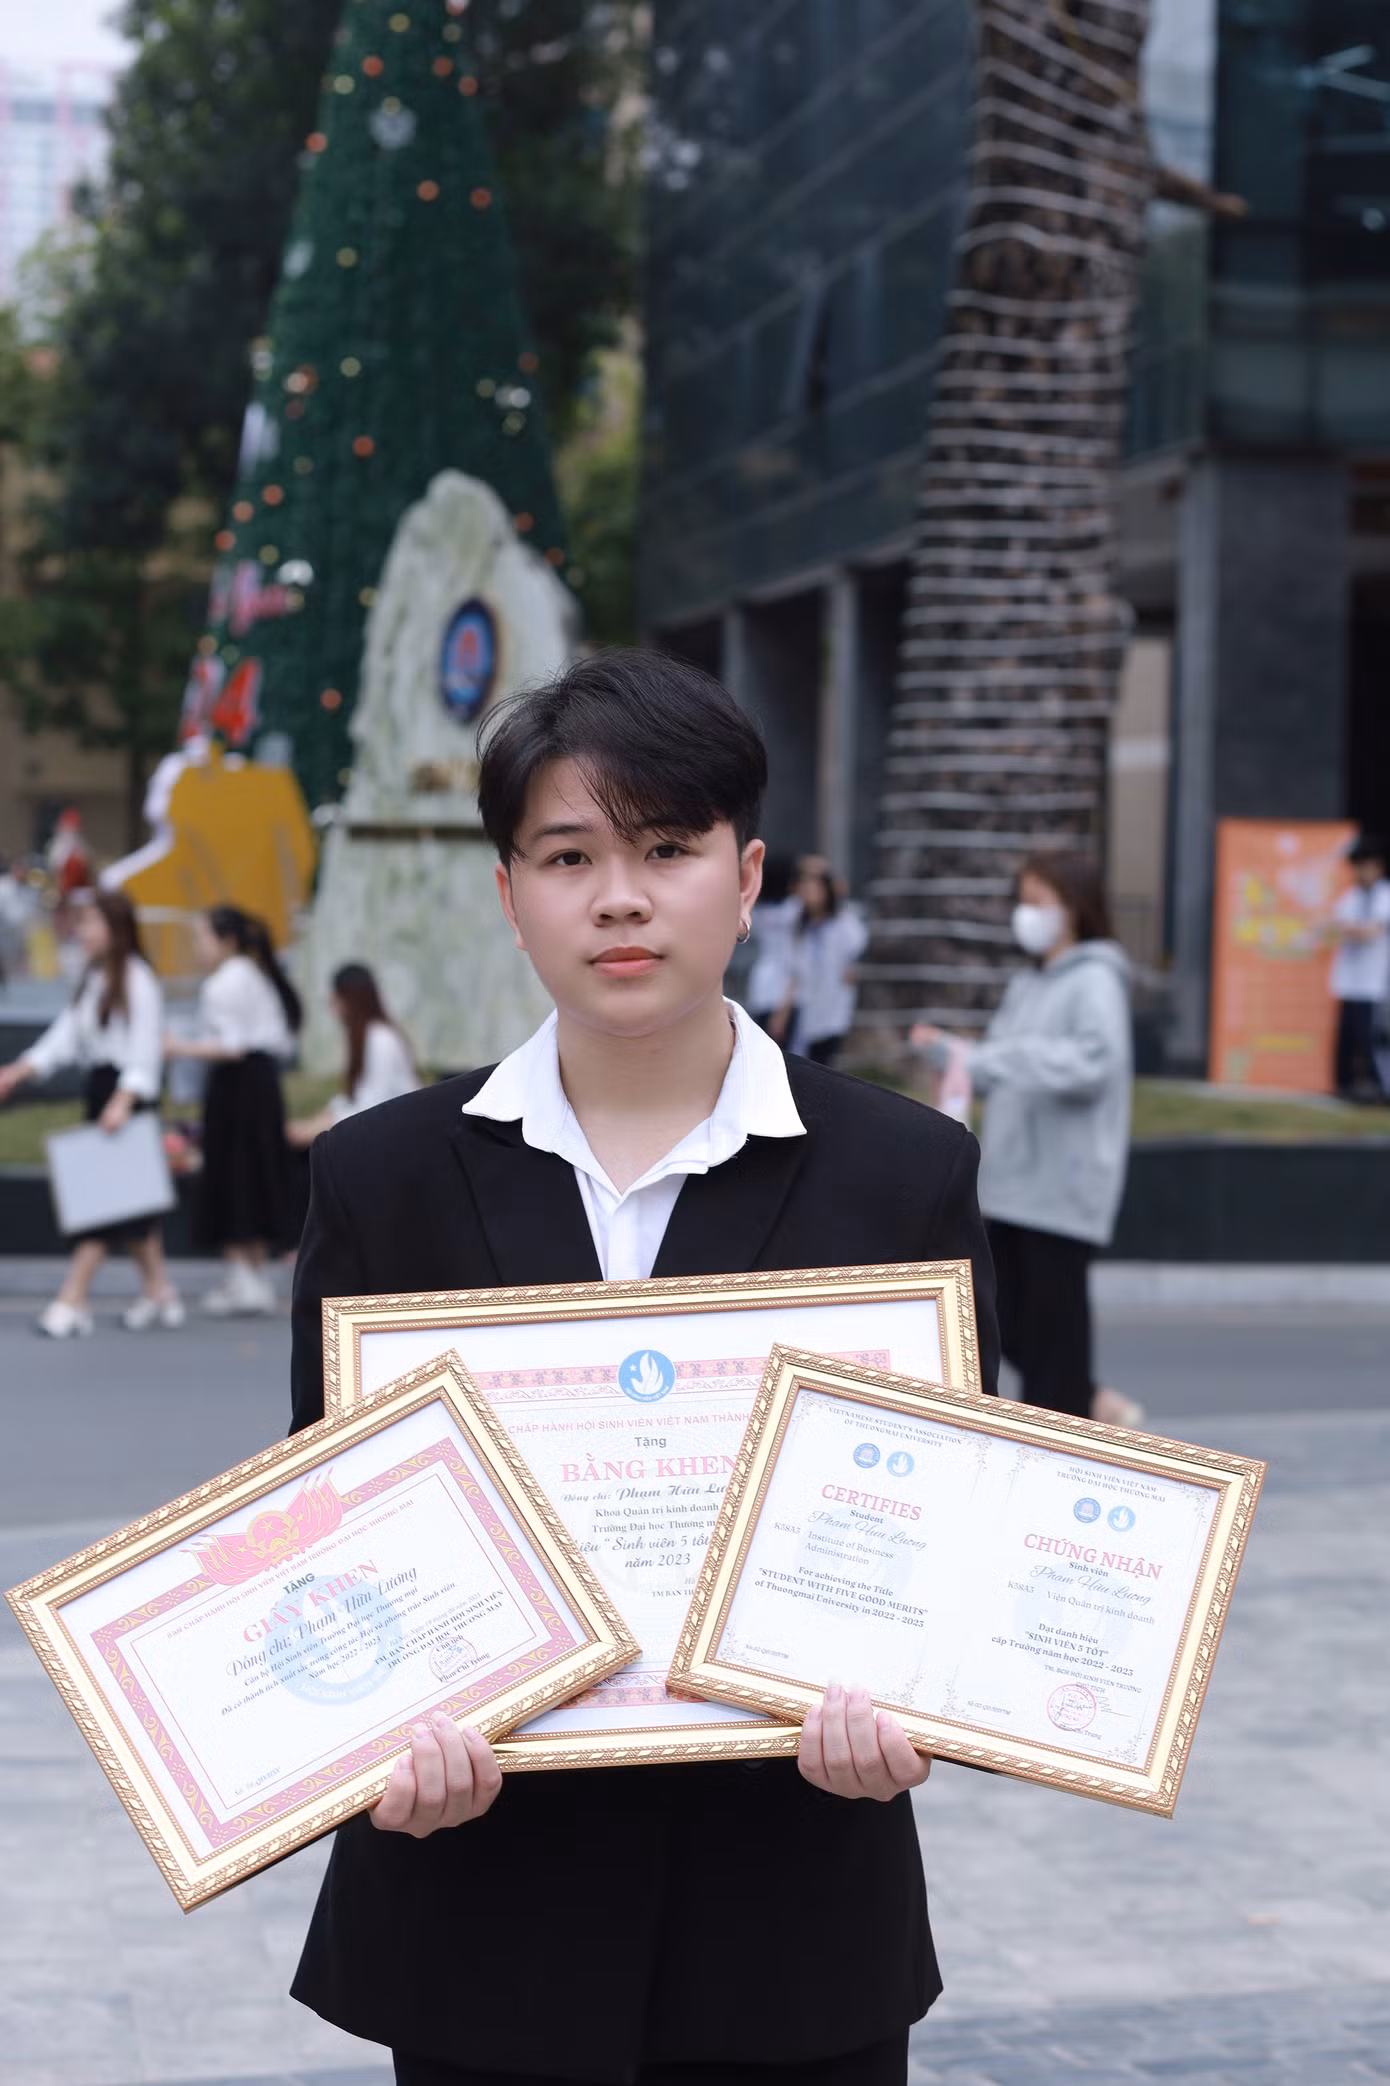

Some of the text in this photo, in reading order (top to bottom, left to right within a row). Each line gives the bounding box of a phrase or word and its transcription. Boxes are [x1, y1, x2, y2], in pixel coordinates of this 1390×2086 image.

[597, 1419, 624, 1429] SINH
[627, 1417, 653, 1428] VIÊN
[684, 1415, 710, 1424] NAM
[634, 1437, 667, 1449] Tặng
[914, 1428, 964, 1445] ASSOCIATION
[561, 1453, 646, 1484] BẰNG
[595, 1509, 621, 1517] Khoa
[666, 1505, 688, 1513] kinh
[689, 1503, 719, 1512] doanh
[821, 1484, 922, 1521] CERTIFIES
[850, 1510, 884, 1524] Student
[804, 1542, 869, 1565] Administration
[808, 1531, 845, 1547] Institute
[856, 1543, 894, 1559] Business
[625, 1553, 691, 1568] năm 2023
[1024, 1533, 1164, 1581] CHỨNG NHẬN
[1069, 1561, 1109, 1577] Sinh viên
[283, 1573, 315, 1595] TẶNG
[798, 1566, 894, 1597] For achieving the Title
[243, 1559, 378, 1642] GIẤY KHEN
[808, 1580, 834, 1593] WITH
[835, 1587, 857, 1599] FIVE
[858, 1594, 886, 1606] GOOD
[766, 1581, 815, 1600] Thuongmai
[816, 1594, 861, 1613] University
[861, 1606, 871, 1615] in
[872, 1609, 895, 1621] 2022
[901, 1616, 925, 1628] 2023
[1105, 1605, 1126, 1617] kinh
[1127, 1611, 1155, 1625] doanh
[1055, 1628, 1078, 1639] danh
[1054, 1638, 1077, 1650] VIÊN
[1080, 1657, 1104, 1669] 2022
[1110, 1665, 1134, 1676] 2023
